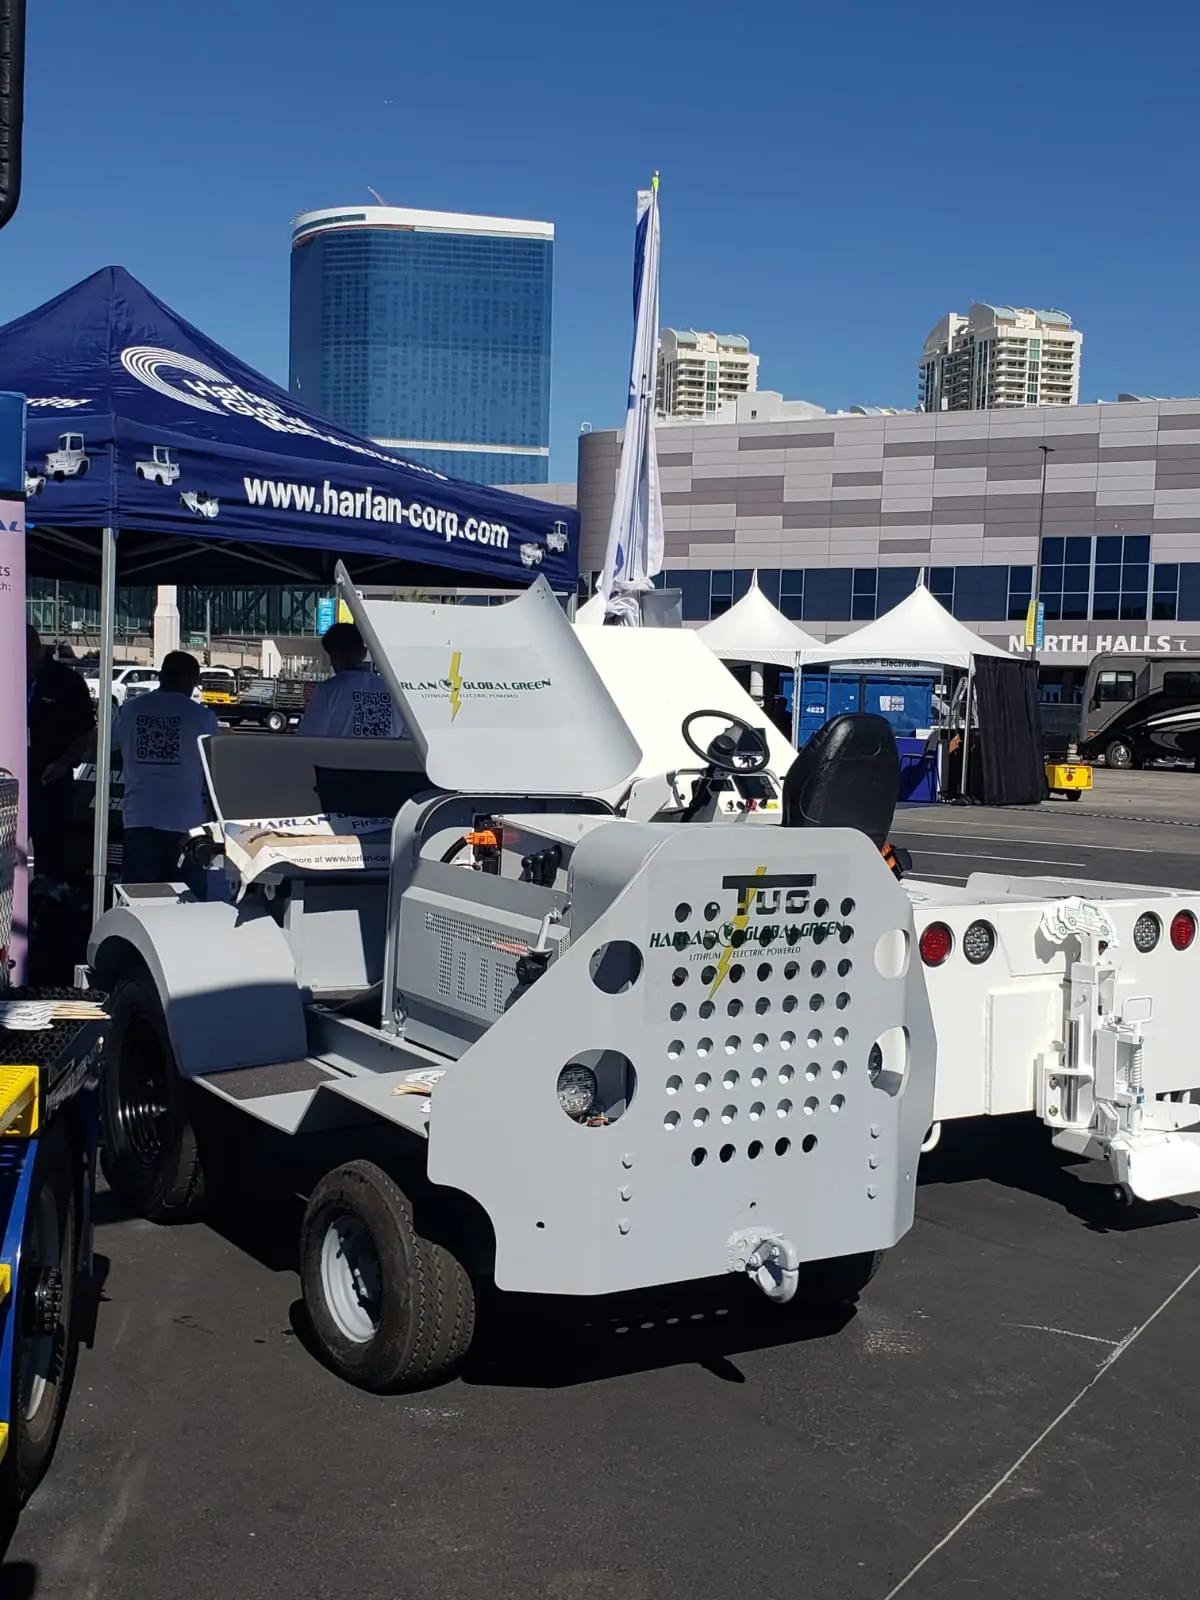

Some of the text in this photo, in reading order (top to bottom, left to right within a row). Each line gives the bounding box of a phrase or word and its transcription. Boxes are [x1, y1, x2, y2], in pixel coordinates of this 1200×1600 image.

[243, 476, 509, 549] www.harlan-corp.com
[1008, 635, 1171, 652] NRTH HALLS
[880, 659, 920, 668] Electrical
[400, 680, 438, 690] RLAN
[722, 873, 817, 916] TUG
[689, 946, 801, 961] LITHIUM ELECTRIC POWERED
